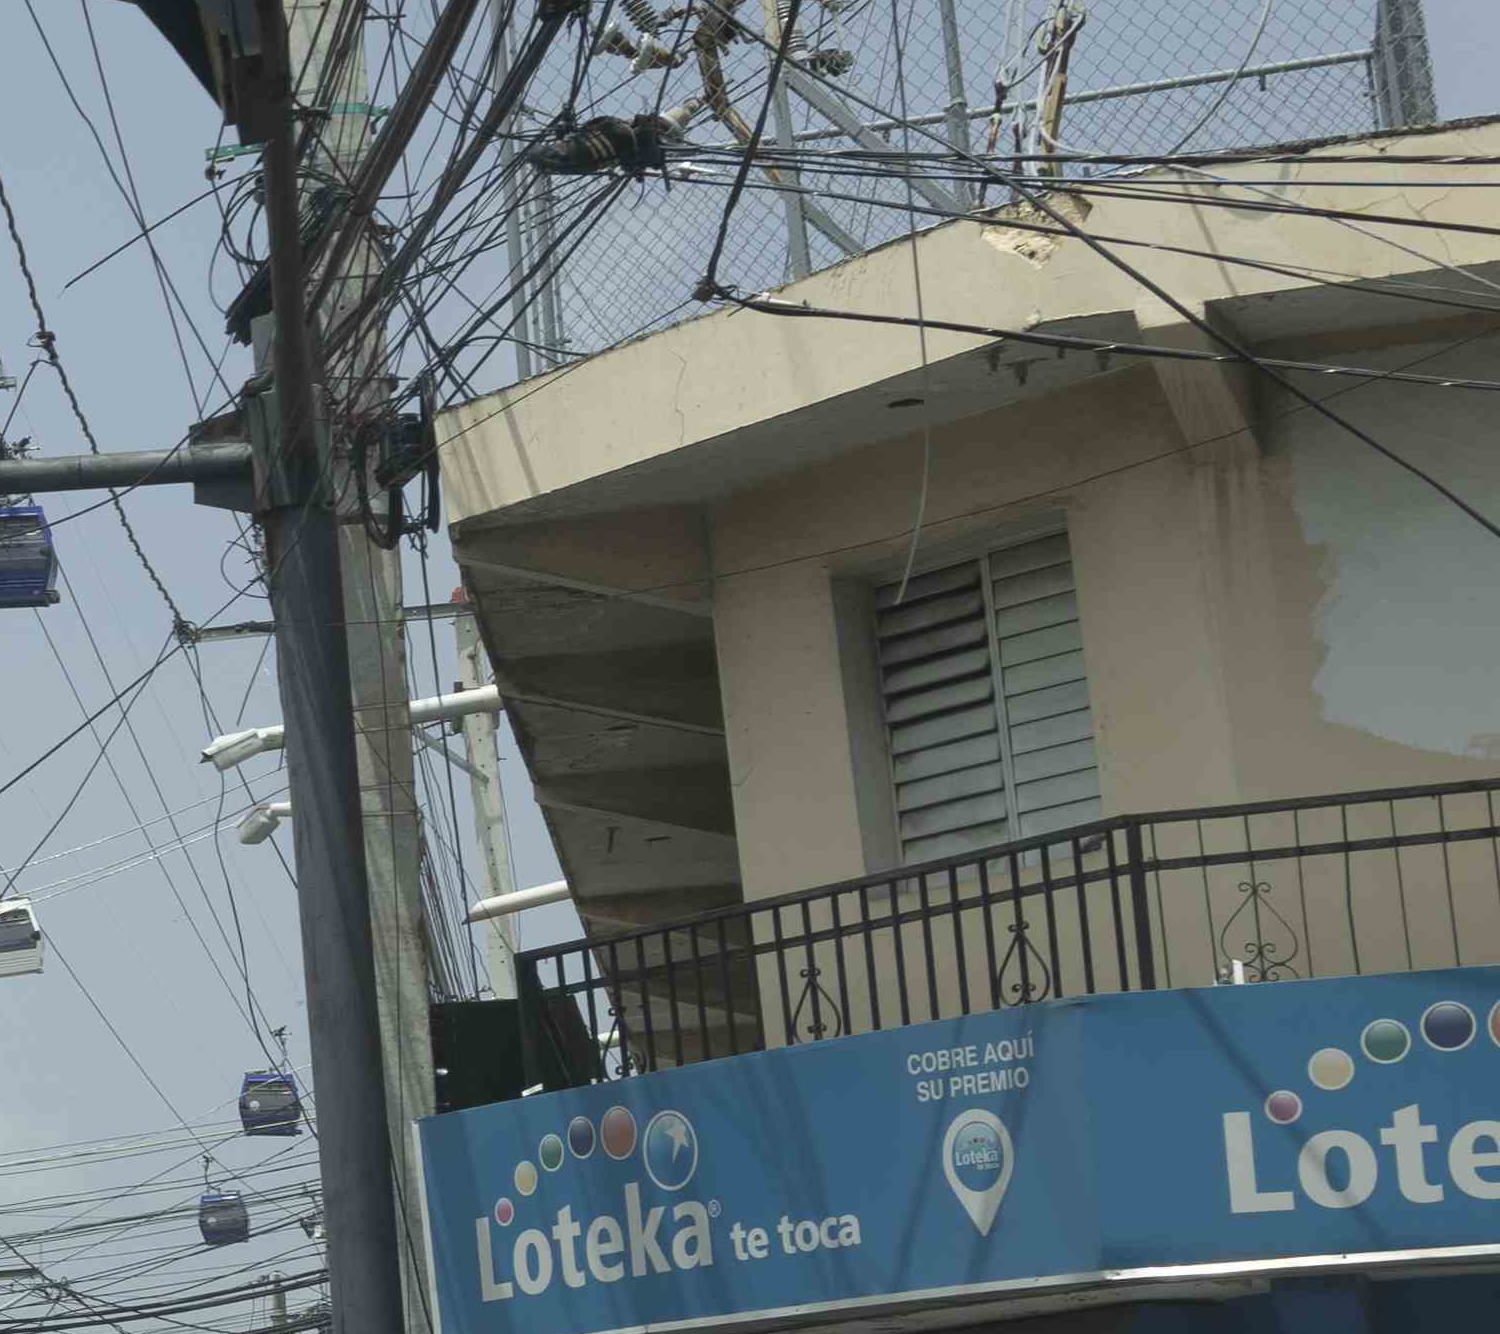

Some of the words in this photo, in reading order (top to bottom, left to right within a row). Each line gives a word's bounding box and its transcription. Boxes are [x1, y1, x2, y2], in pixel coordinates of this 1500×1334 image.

[907, 1046, 979, 1075] COBRE
[984, 1031, 1035, 1065] AQUÍ
[916, 1080, 944, 1102] SU
[950, 1067, 1029, 1098] PREMIO
[477, 1181, 714, 1302] Loteka
[729, 1220, 770, 1262] te
[776, 1214, 861, 1251] toca
